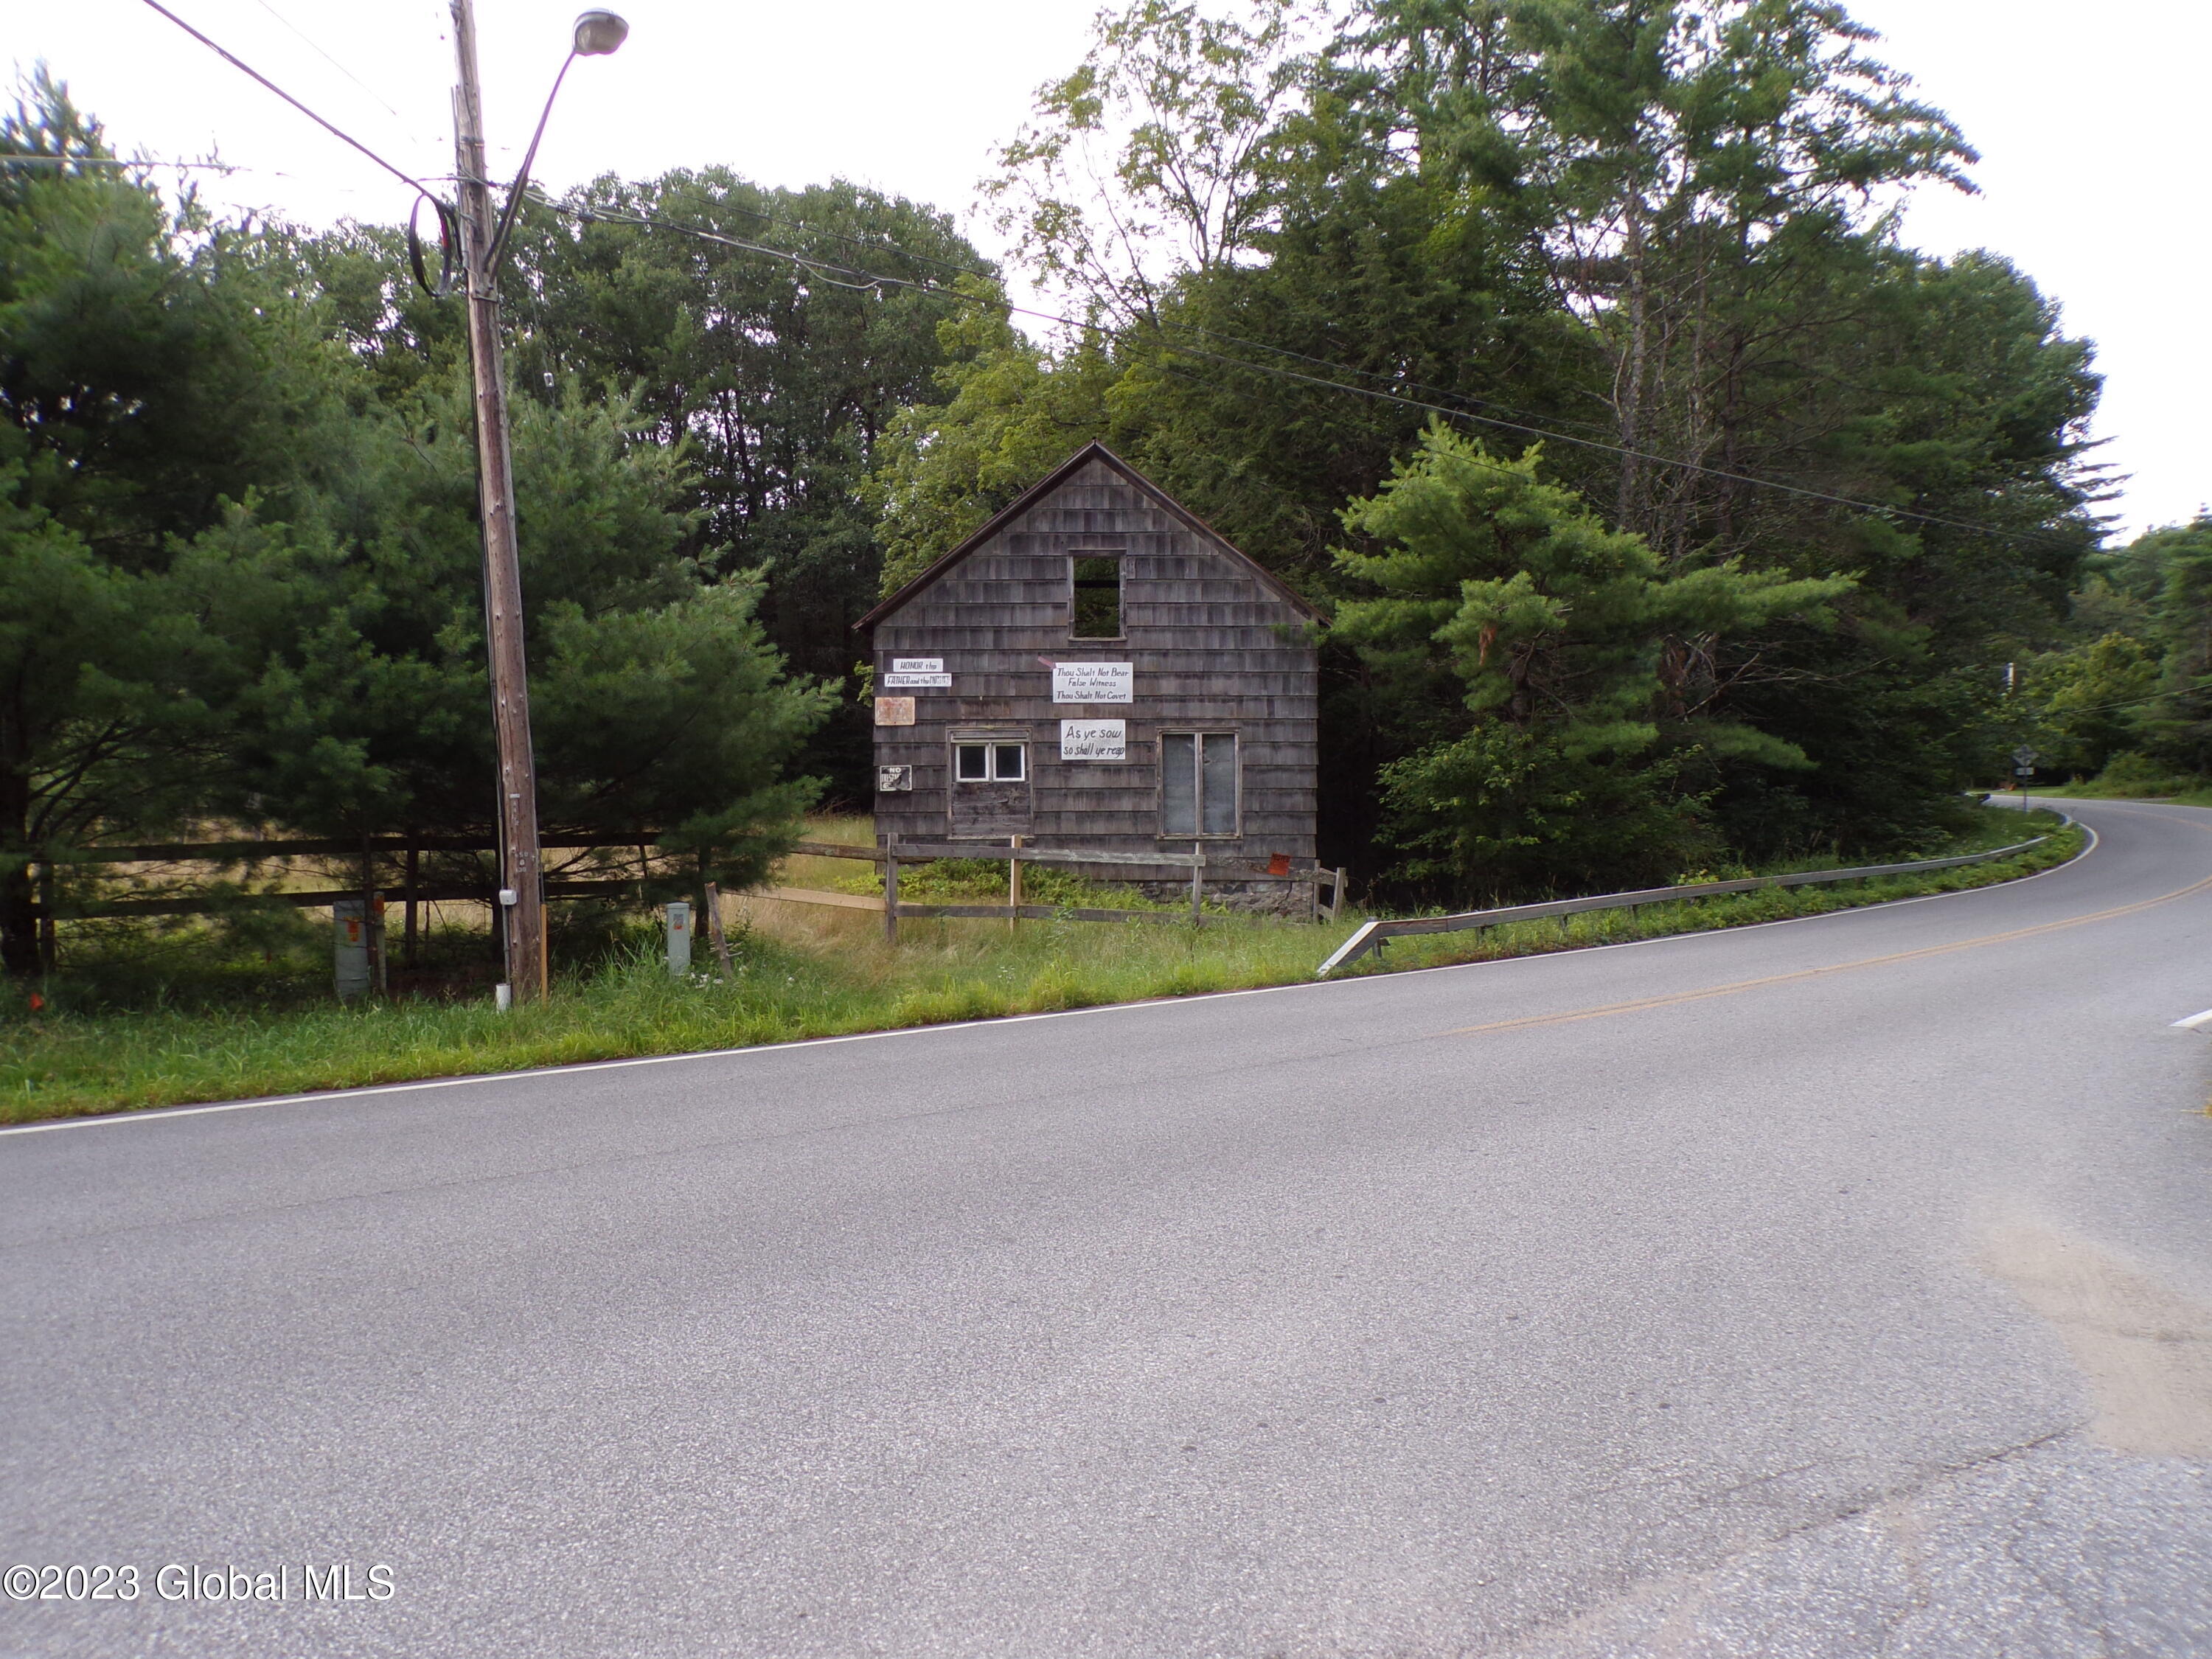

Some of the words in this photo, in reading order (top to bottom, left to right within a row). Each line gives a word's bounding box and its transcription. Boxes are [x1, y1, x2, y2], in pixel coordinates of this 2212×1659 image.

[900, 661, 923, 669] HONOR
[1057, 667, 1074, 677] Thou
[1076, 667, 1095, 677] Shalt
[1097, 667, 1110, 677] Not
[1111, 667, 1130, 677] Bear
[887, 676, 911, 685] FATHER
[1068, 678, 1087, 686] False
[1090, 678, 1117, 686] Witness
[1057, 691, 1074, 700] Thou
[1074, 690, 1093, 700] Shalt
[1094, 691, 1106, 700] Not
[1107, 691, 1127, 700] Covet
[1065, 726, 1081, 739] As
[1084, 730, 1096, 741] ye
[1099, 729, 1121, 738] sow
[1063, 746, 1074, 755] so
[1074, 742, 1093, 755] shall
[1096, 747, 1106, 757] ye
[1107, 746, 1125, 758] reap
